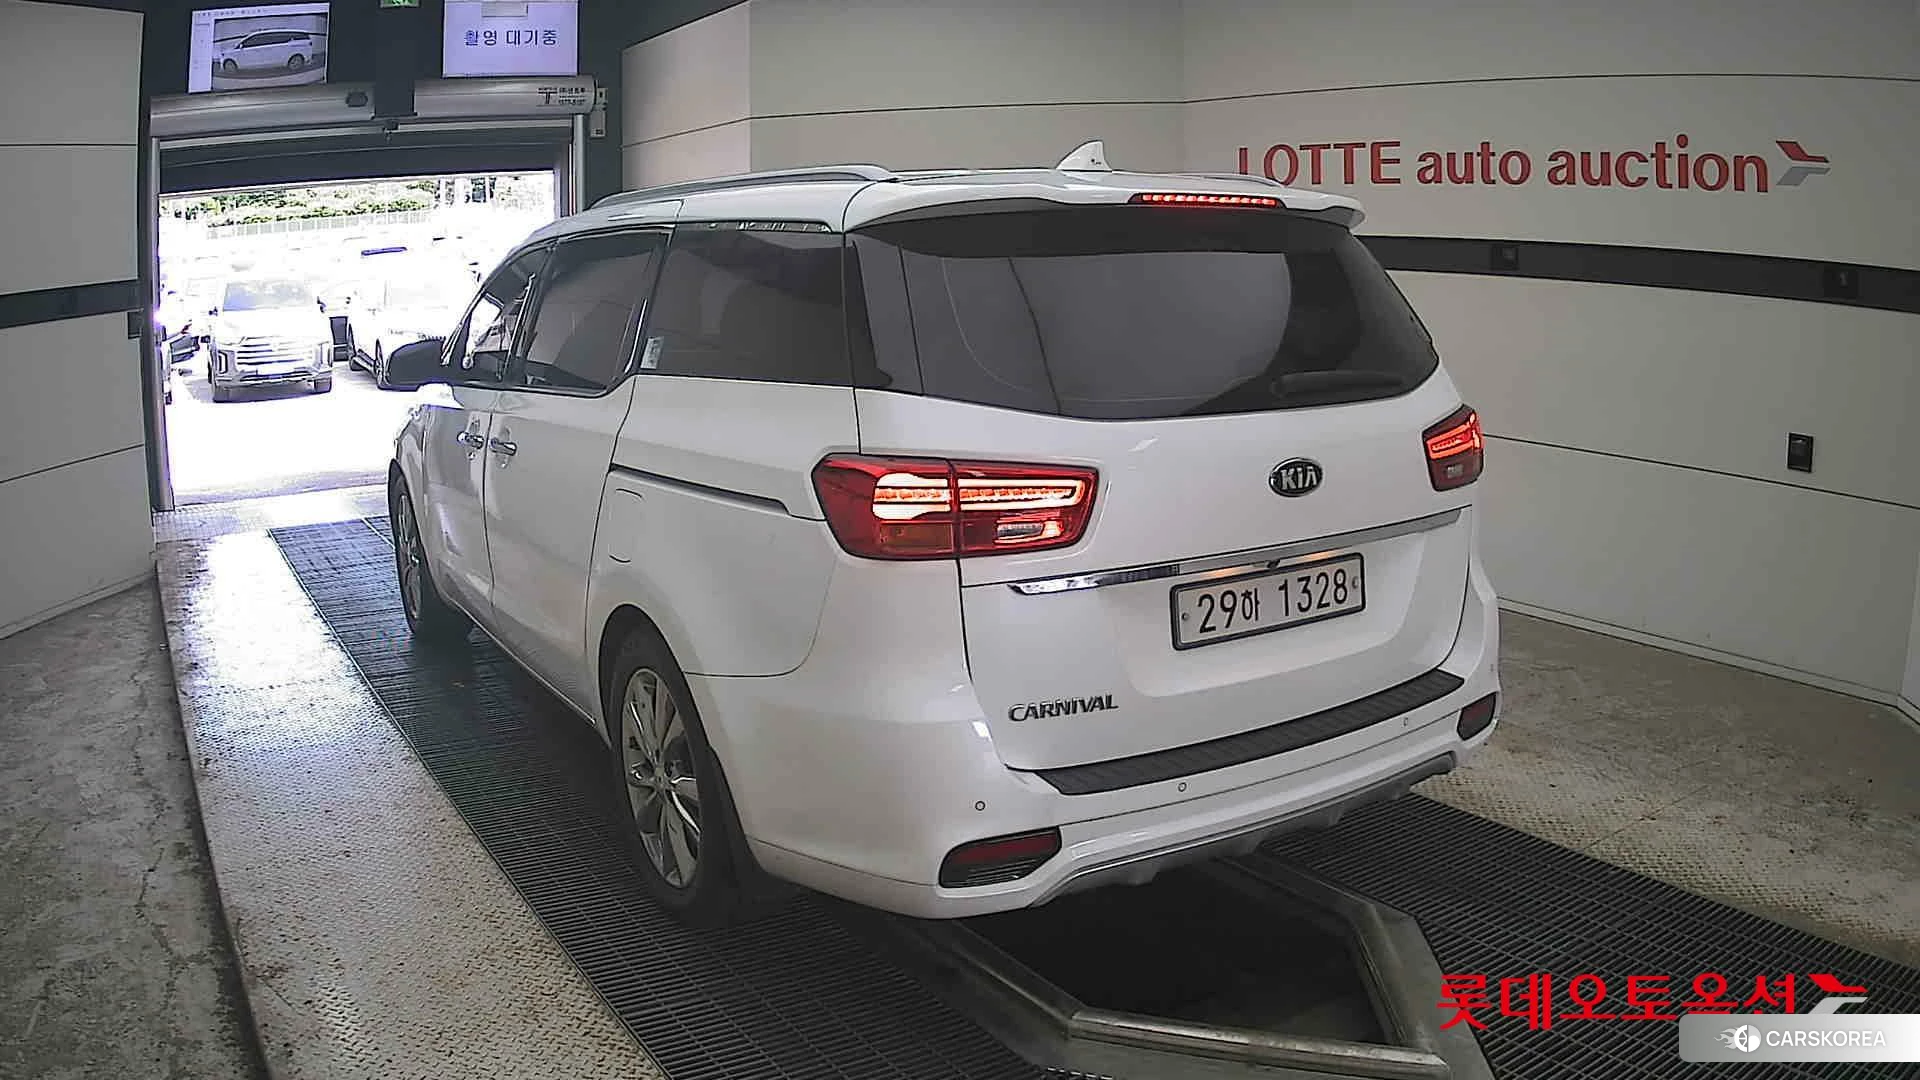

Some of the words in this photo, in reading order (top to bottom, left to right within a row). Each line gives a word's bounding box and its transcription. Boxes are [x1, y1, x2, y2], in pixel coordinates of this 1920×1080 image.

[465, 29, 498, 46] 촬영
[505, 29, 558, 46] 대기중
[1416, 141, 1532, 185] auto
[1547, 133, 1769, 194] auction
[1280, 465, 1317, 490] KIA
[1198, 587, 1260, 633] 29하
[1278, 570, 1348, 617] 1328
[1008, 694, 1119, 722] CARNIVAL
